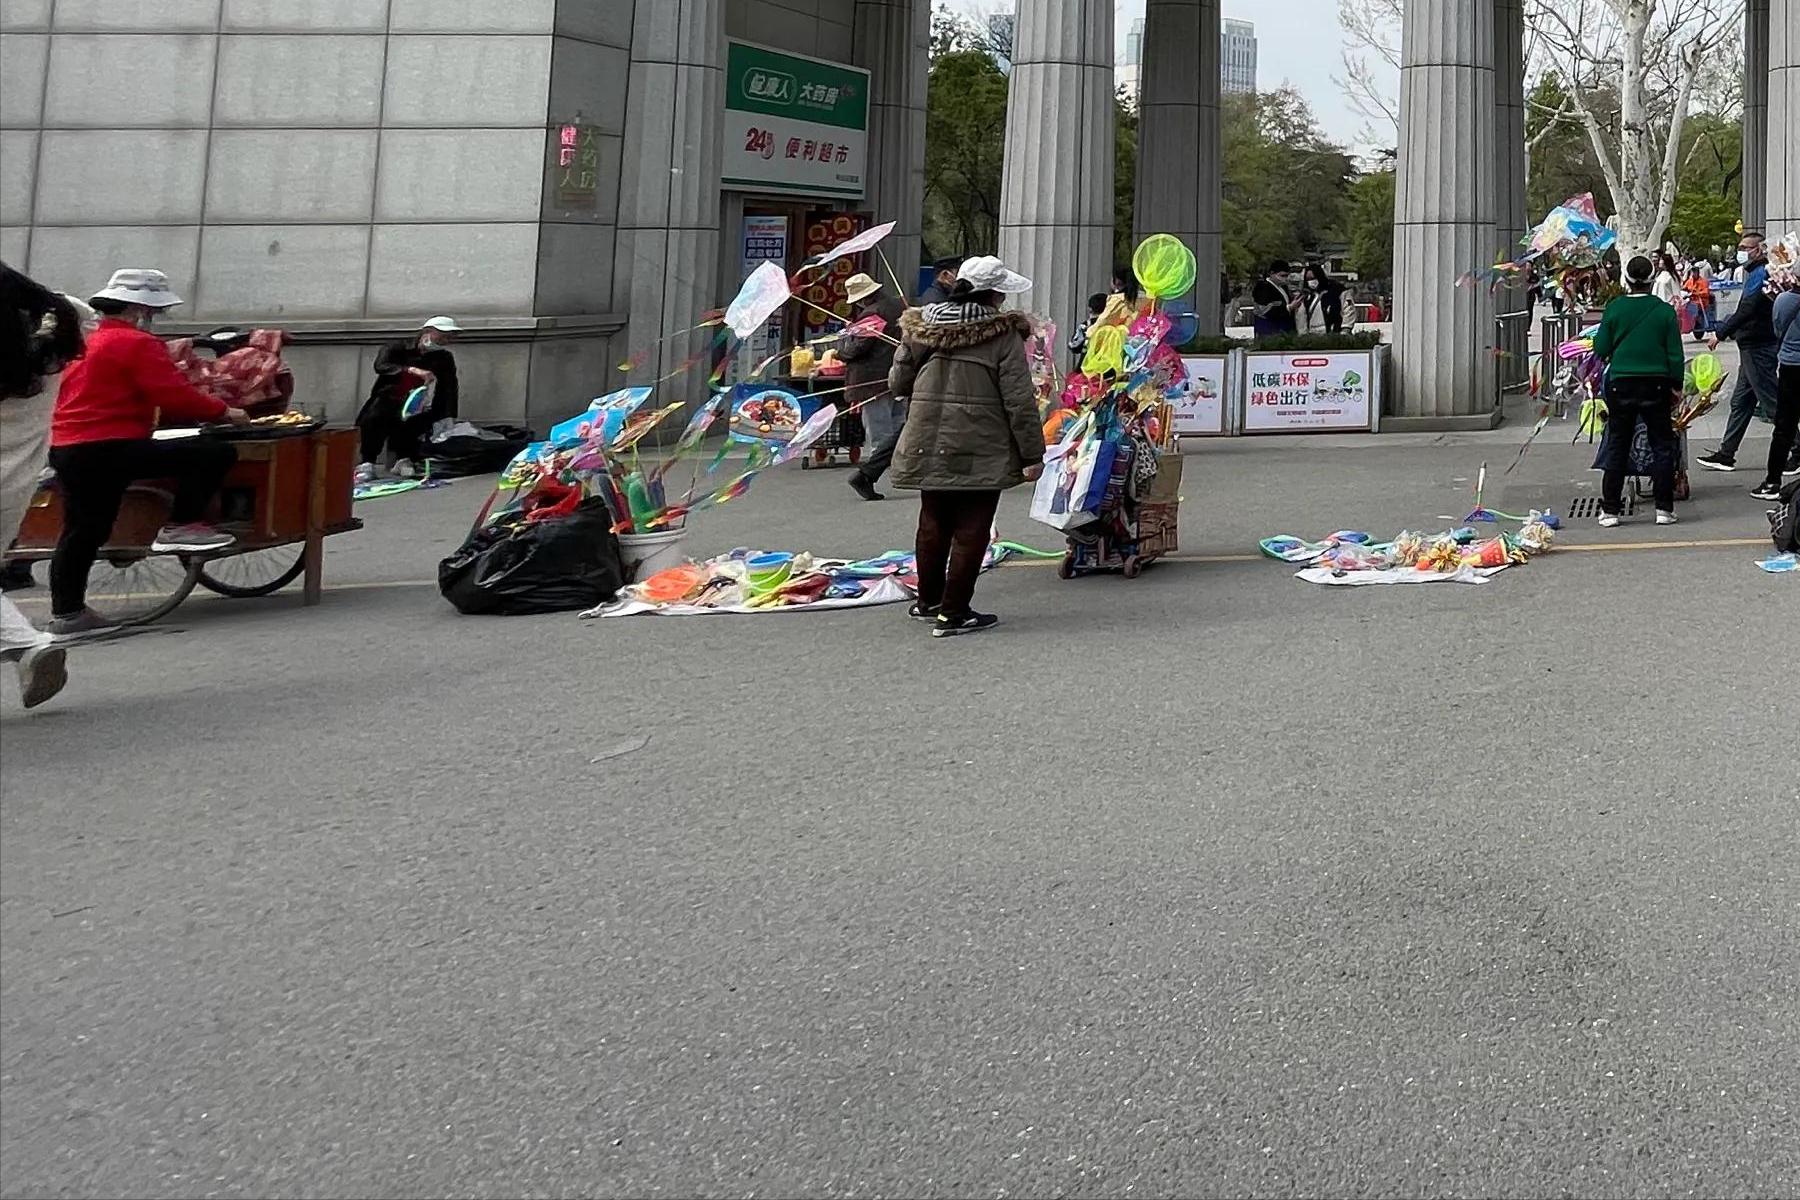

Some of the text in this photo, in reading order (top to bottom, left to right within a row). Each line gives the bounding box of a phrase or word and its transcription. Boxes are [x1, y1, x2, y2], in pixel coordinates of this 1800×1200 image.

[800, 82, 839, 105] 大药房
[744, 127, 768, 152] 24
[785, 137, 849, 165] 便利超市
[1252, 371, 1310, 388] 低碳环保
[1250, 389, 1309, 406] 绿色出行
